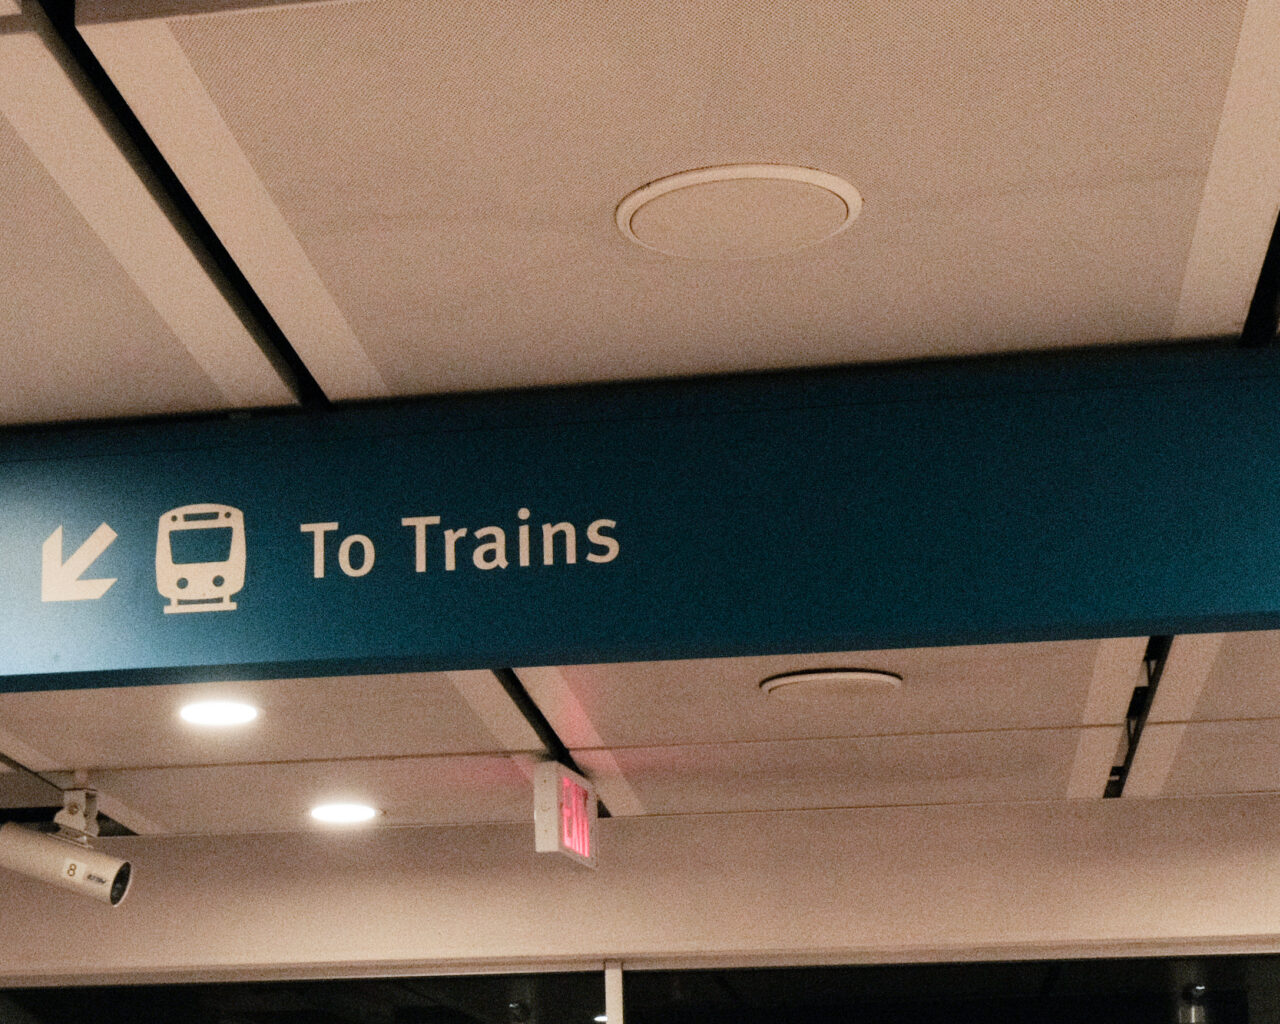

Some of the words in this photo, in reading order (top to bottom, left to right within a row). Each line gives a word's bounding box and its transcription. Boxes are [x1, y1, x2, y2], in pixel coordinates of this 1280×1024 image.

[299, 521, 376, 579] To
[400, 507, 620, 573] Trains
[66, 863, 77, 877] 8
